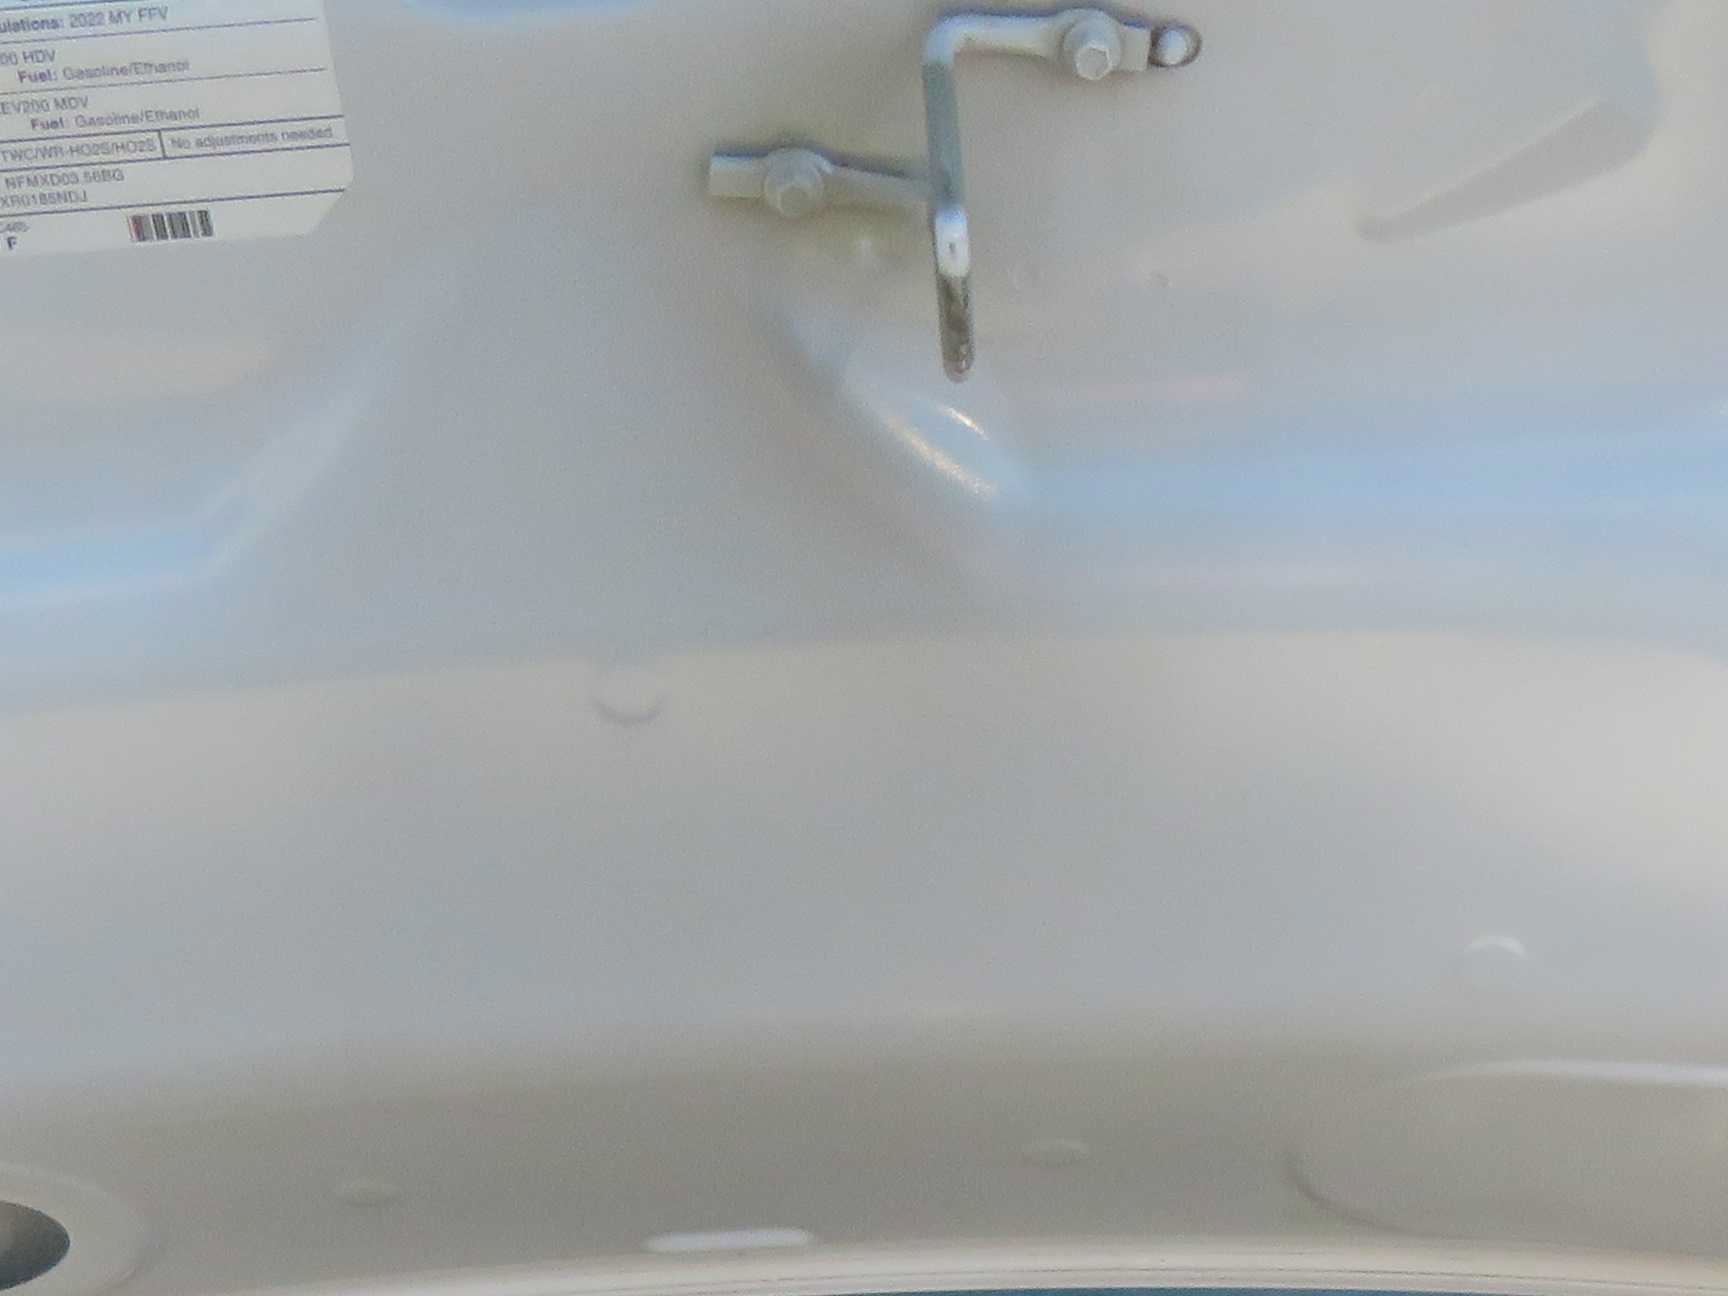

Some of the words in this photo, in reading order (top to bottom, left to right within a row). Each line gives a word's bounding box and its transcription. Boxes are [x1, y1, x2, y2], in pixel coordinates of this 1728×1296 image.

[69, 13, 105, 28] 2022
[109, 9, 131, 23] MY
[138, 6, 169, 21] FFV
[16, 68, 57, 84] Fuel:
[62, 60, 190, 81] Gasoline/Ethanol
[53, 96, 89, 111] MDV
[74, 107, 201, 129] Gasoline/Ethanol
[170, 137, 191, 150] No
[195, 131, 277, 150] adjustments
[281, 126, 334, 141] needed
